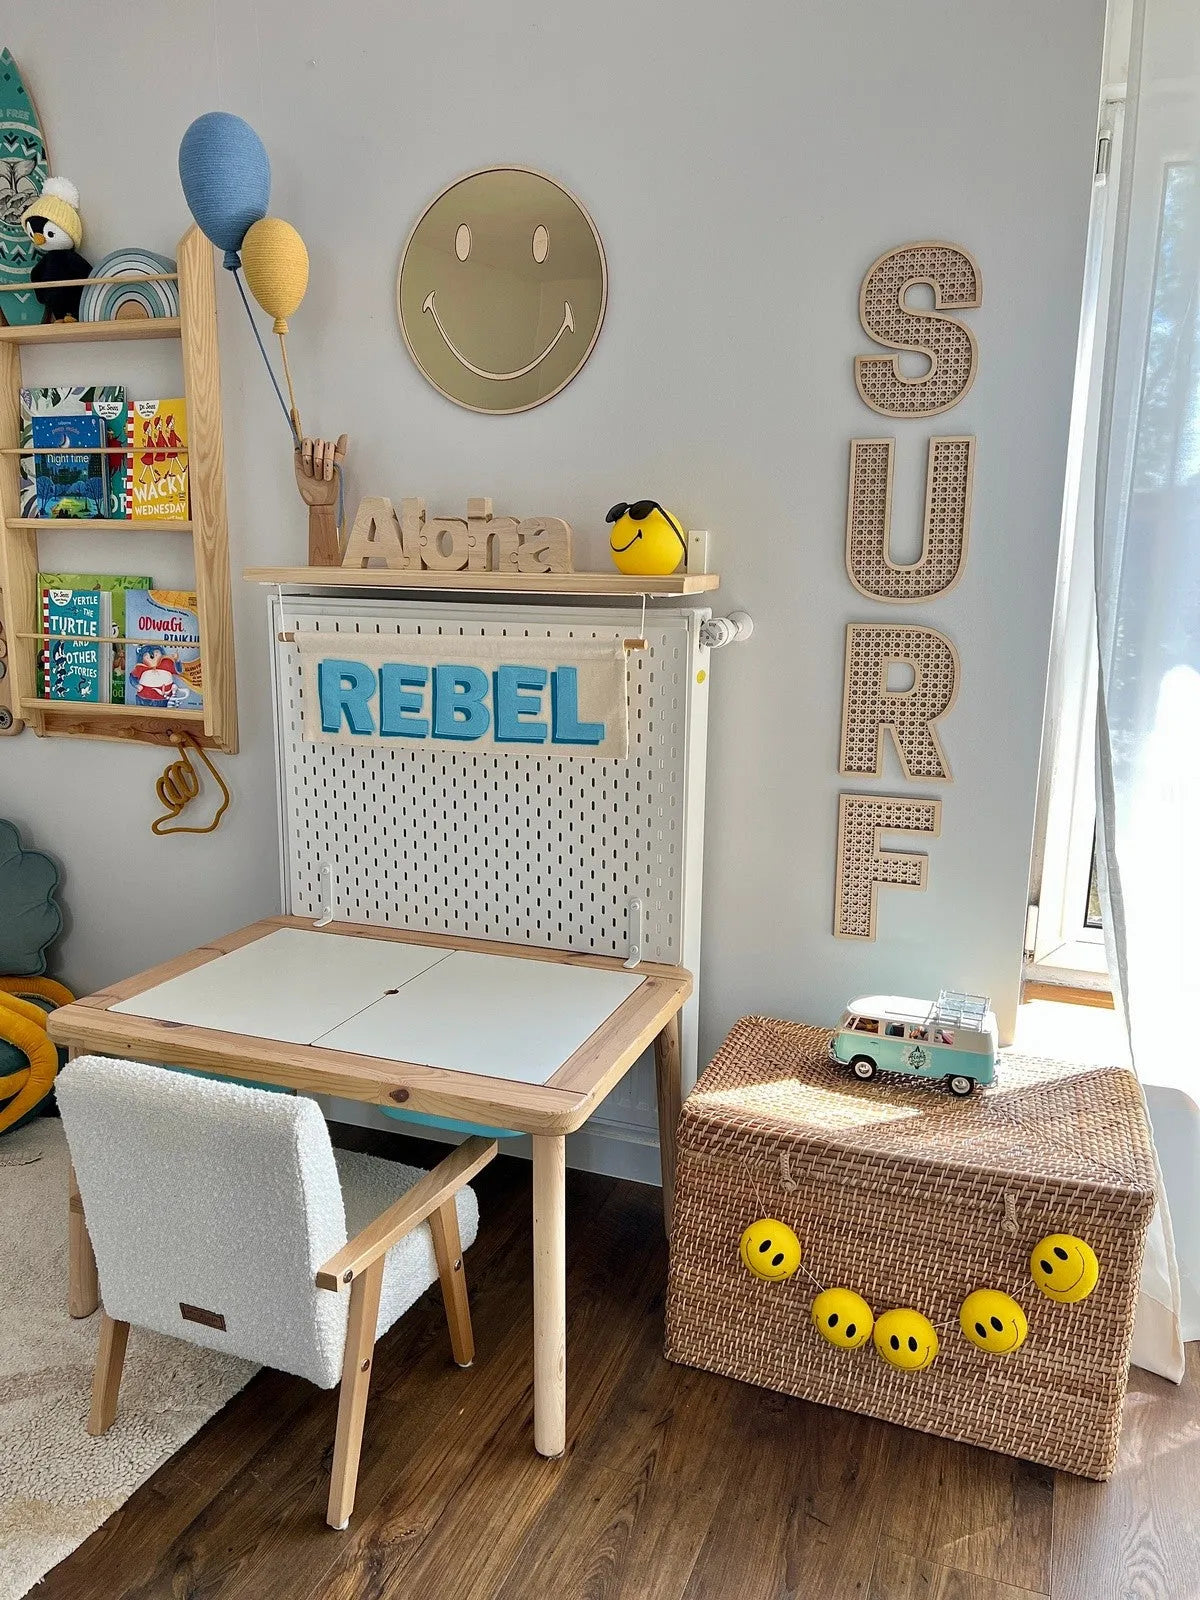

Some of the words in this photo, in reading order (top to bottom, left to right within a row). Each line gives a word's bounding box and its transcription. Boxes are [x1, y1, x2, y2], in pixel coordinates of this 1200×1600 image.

[133, 472, 187, 503] WACKY
[134, 502, 186, 516] WEDNESDAY
[341, 496, 575, 574] Aloha
[834, 240, 983, 941] SURF
[72, 595, 98, 606] YERTLE
[83, 607, 94, 618] THE
[50, 615, 97, 637] TURTLE
[72, 639, 89, 648] AND
[66, 650, 97, 664] OTHER
[69, 664, 97, 679] STORIES
[317, 658, 605, 746] REBEL
